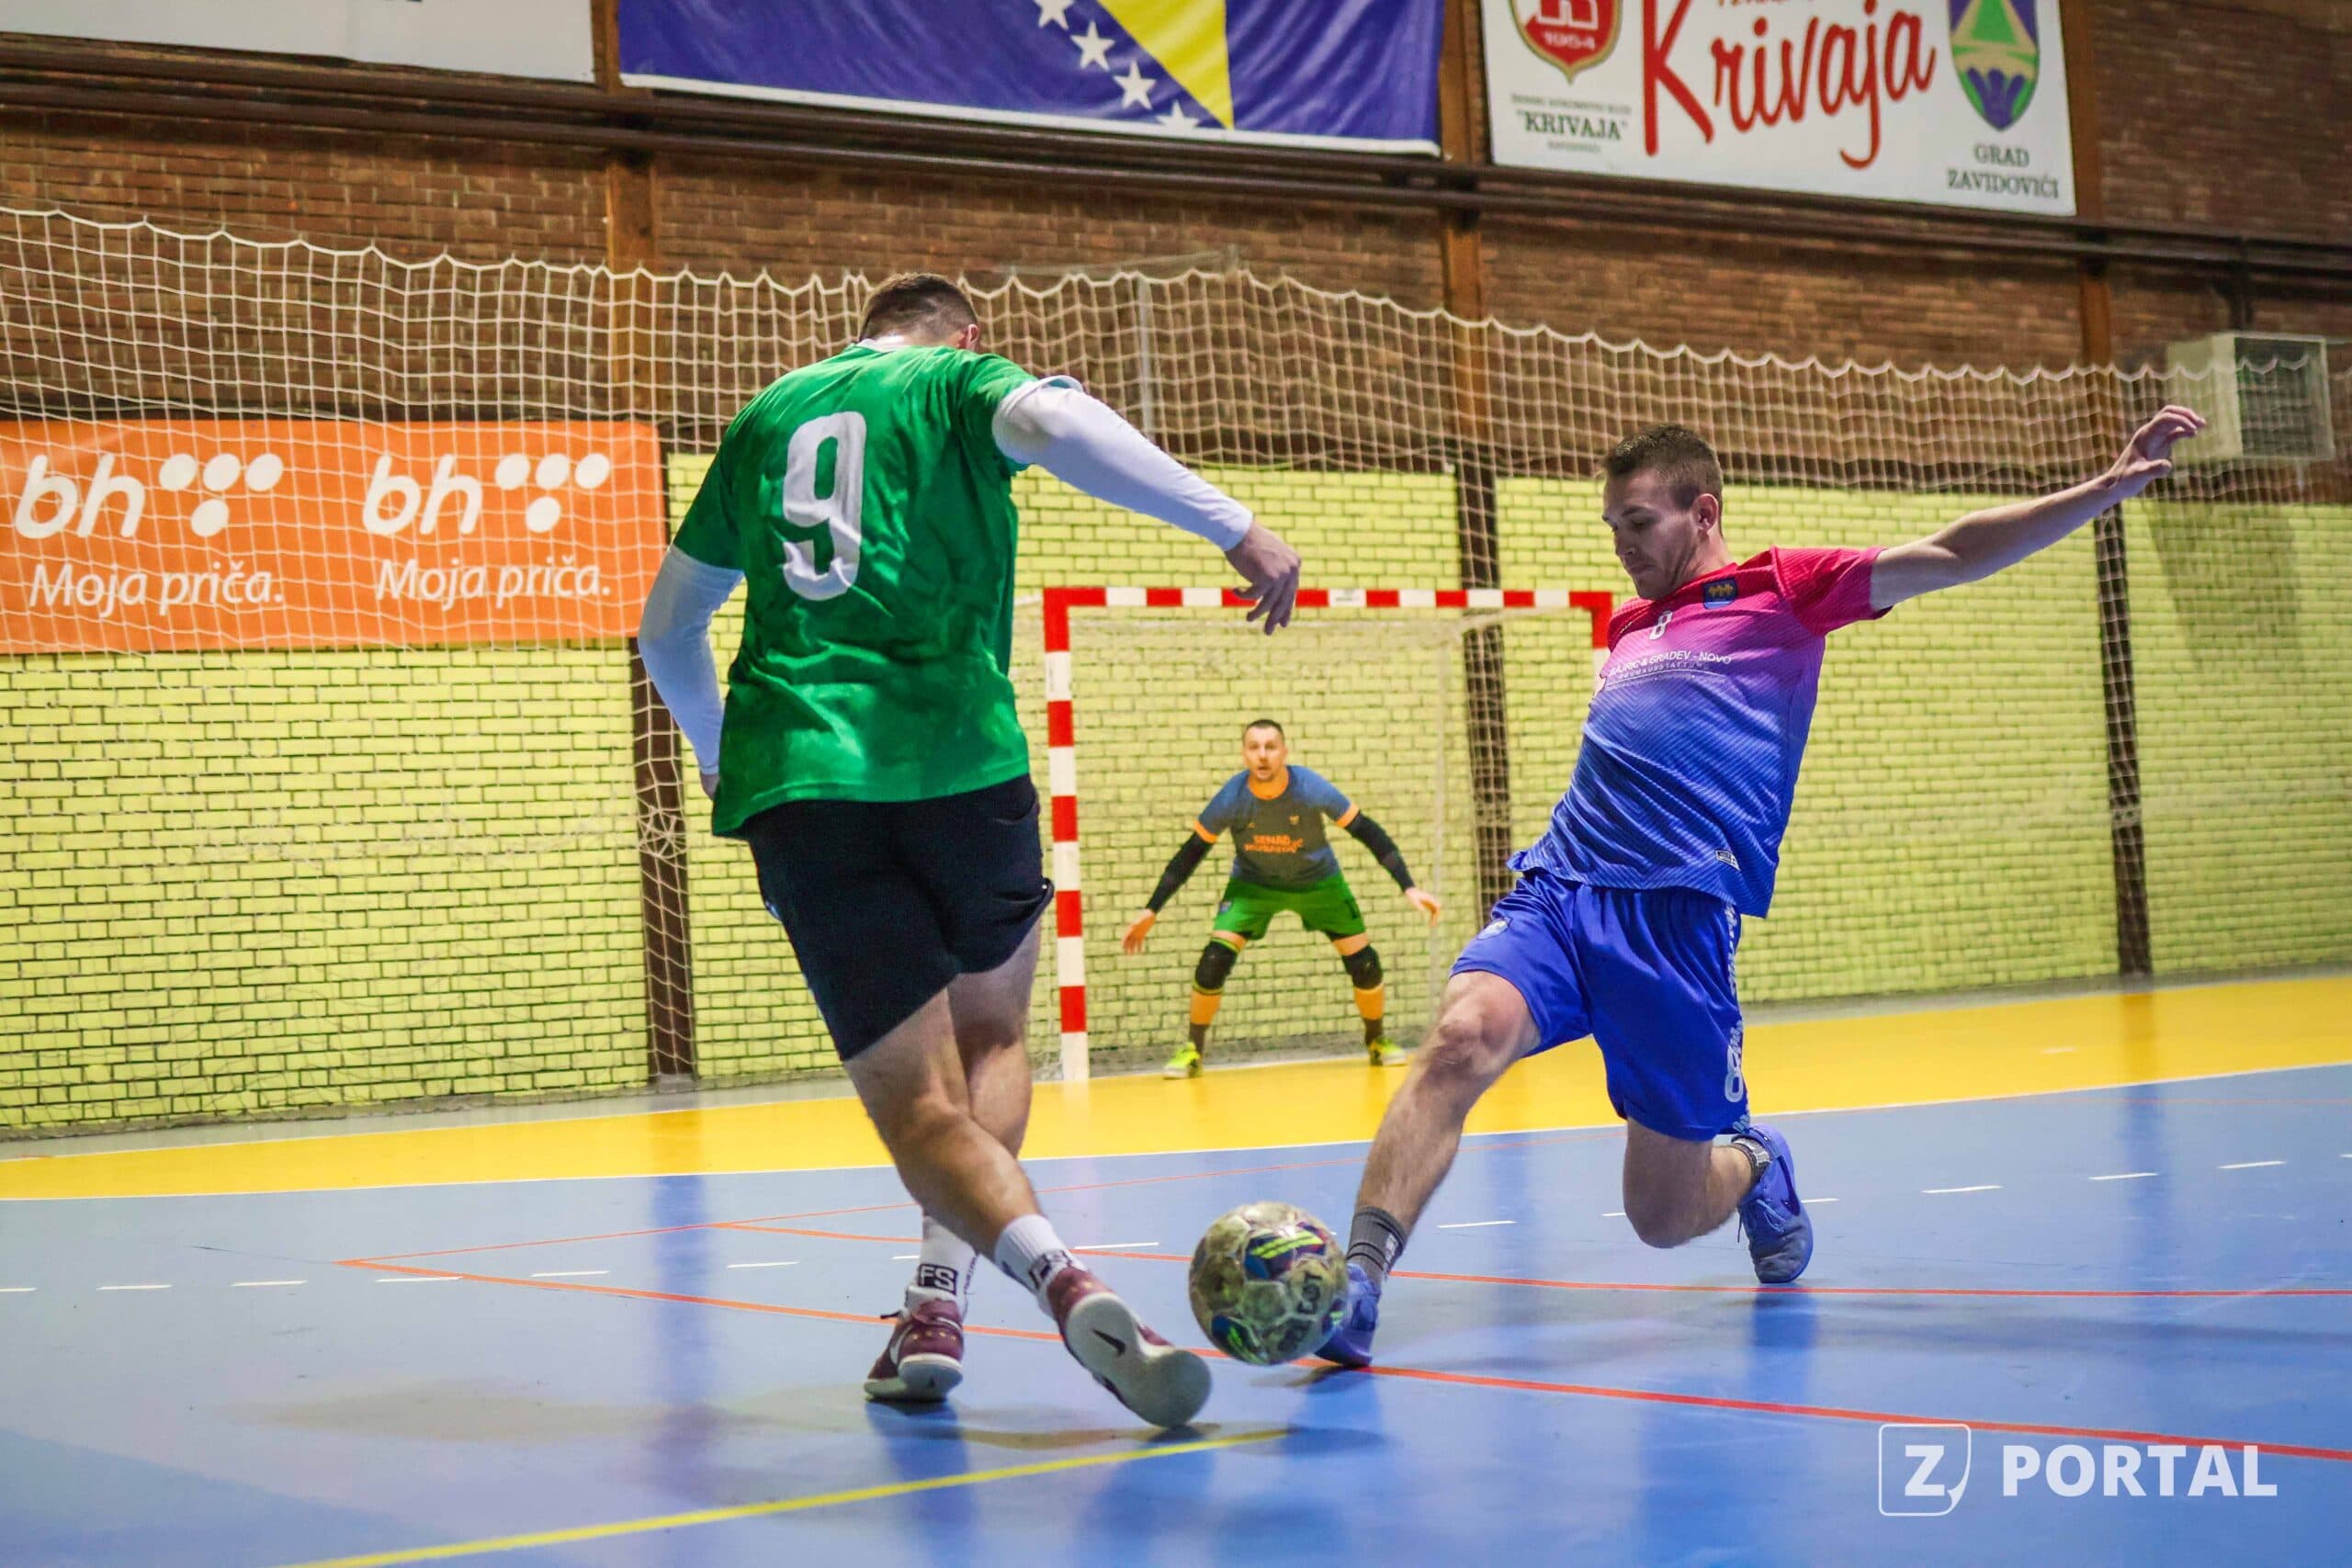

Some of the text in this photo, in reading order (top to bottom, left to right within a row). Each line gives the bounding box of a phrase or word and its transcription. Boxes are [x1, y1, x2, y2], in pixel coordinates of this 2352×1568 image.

[1643, 0, 1936, 169] Krivaja
[1946, 168, 2059, 199] ZAVIDOVIĆI
[1973, 144, 2030, 167] GRAD
[14, 453, 145, 539] bh
[362, 454, 483, 536] bh
[781, 411, 867, 601] 9
[28, 561, 284, 618] Moja priča.
[375, 555, 612, 611] Moja priča.
[1649, 611, 1673, 640] 8
[1649, 650, 1691, 665] GRADEV
[1699, 651, 1732, 664] NOVO
